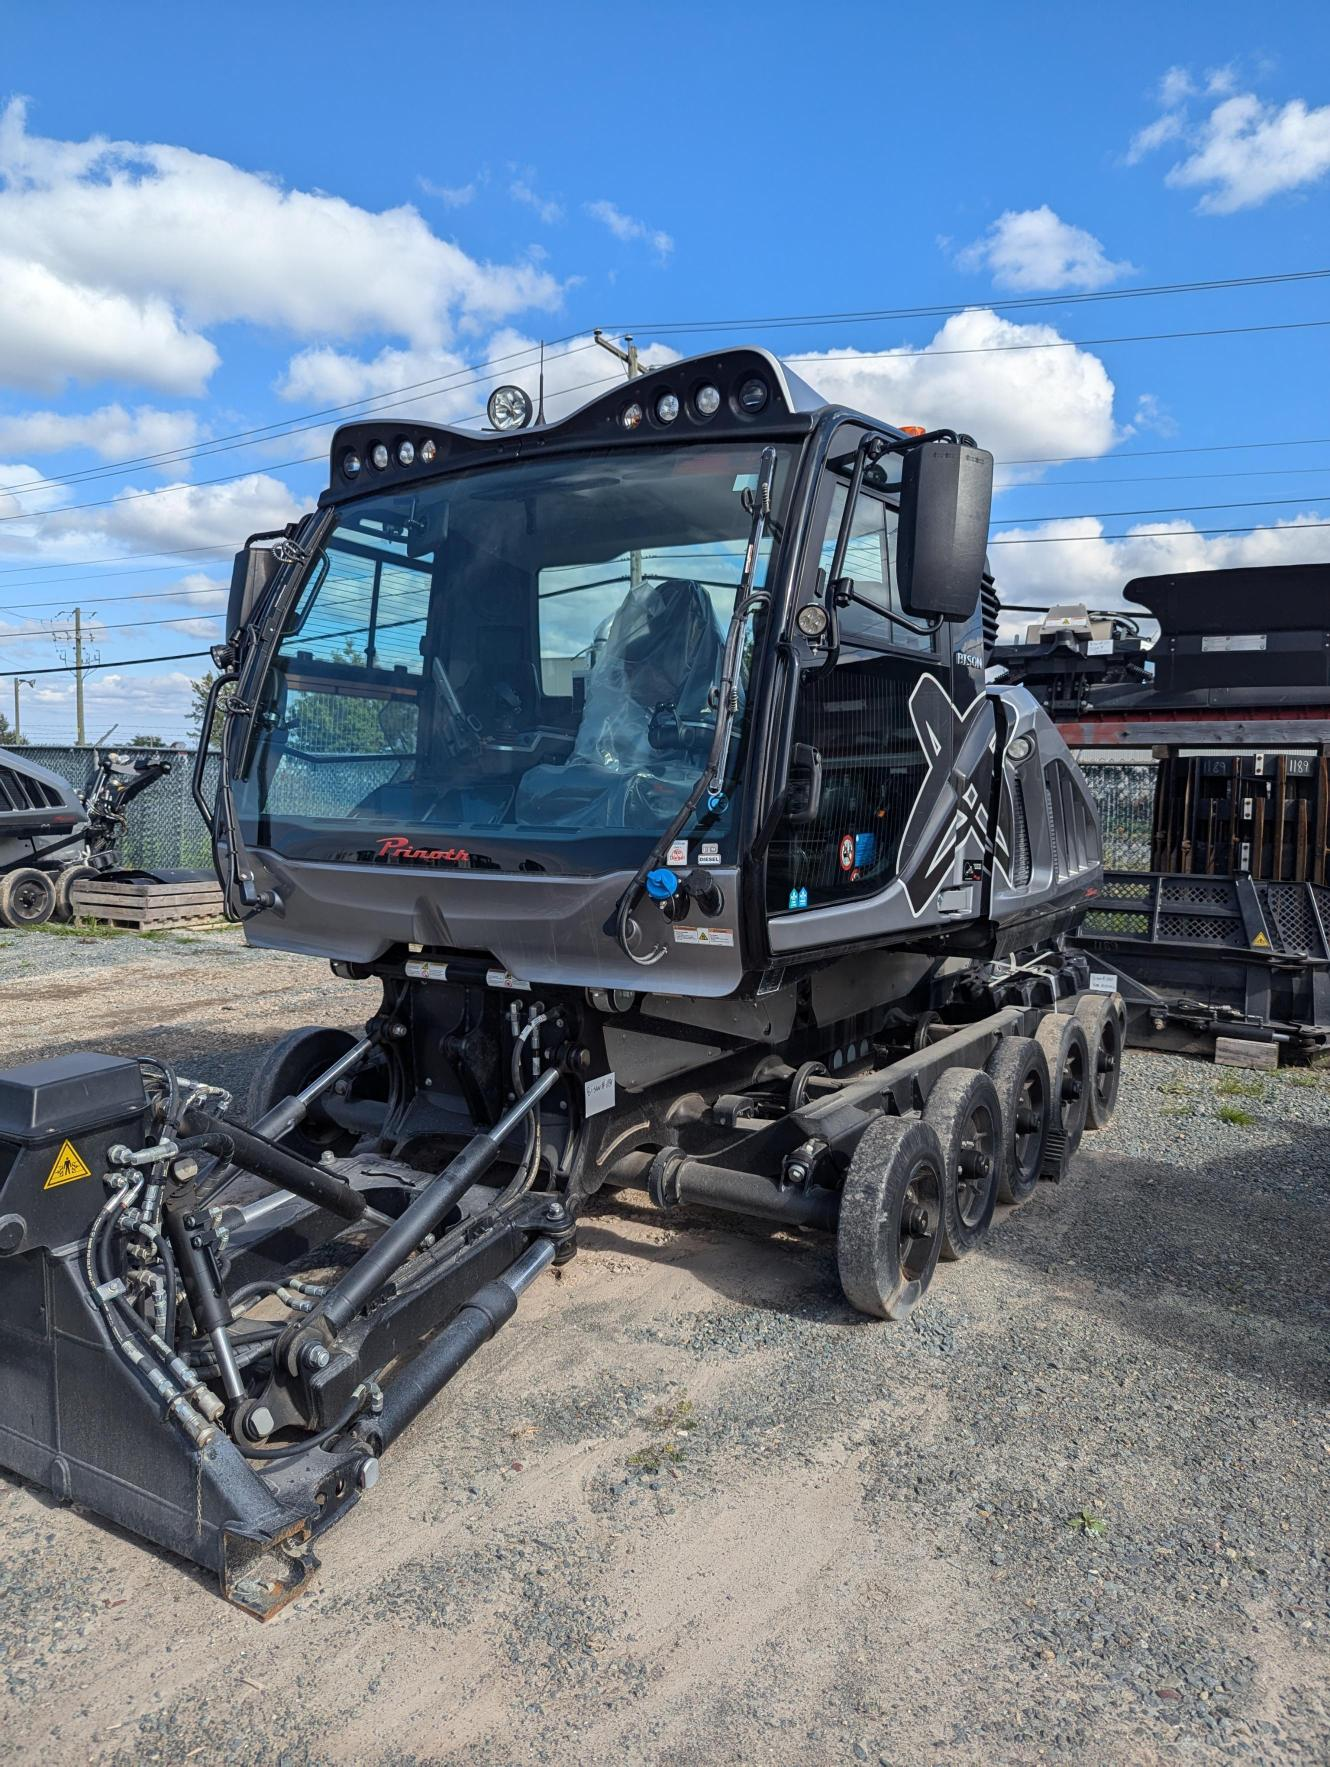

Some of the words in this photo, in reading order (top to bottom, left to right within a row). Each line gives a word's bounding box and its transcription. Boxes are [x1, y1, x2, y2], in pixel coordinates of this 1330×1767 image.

[957, 652, 983, 669] BISON
[1289, 759, 1309, 774] 1189
[376, 837, 470, 860] Prinoth
